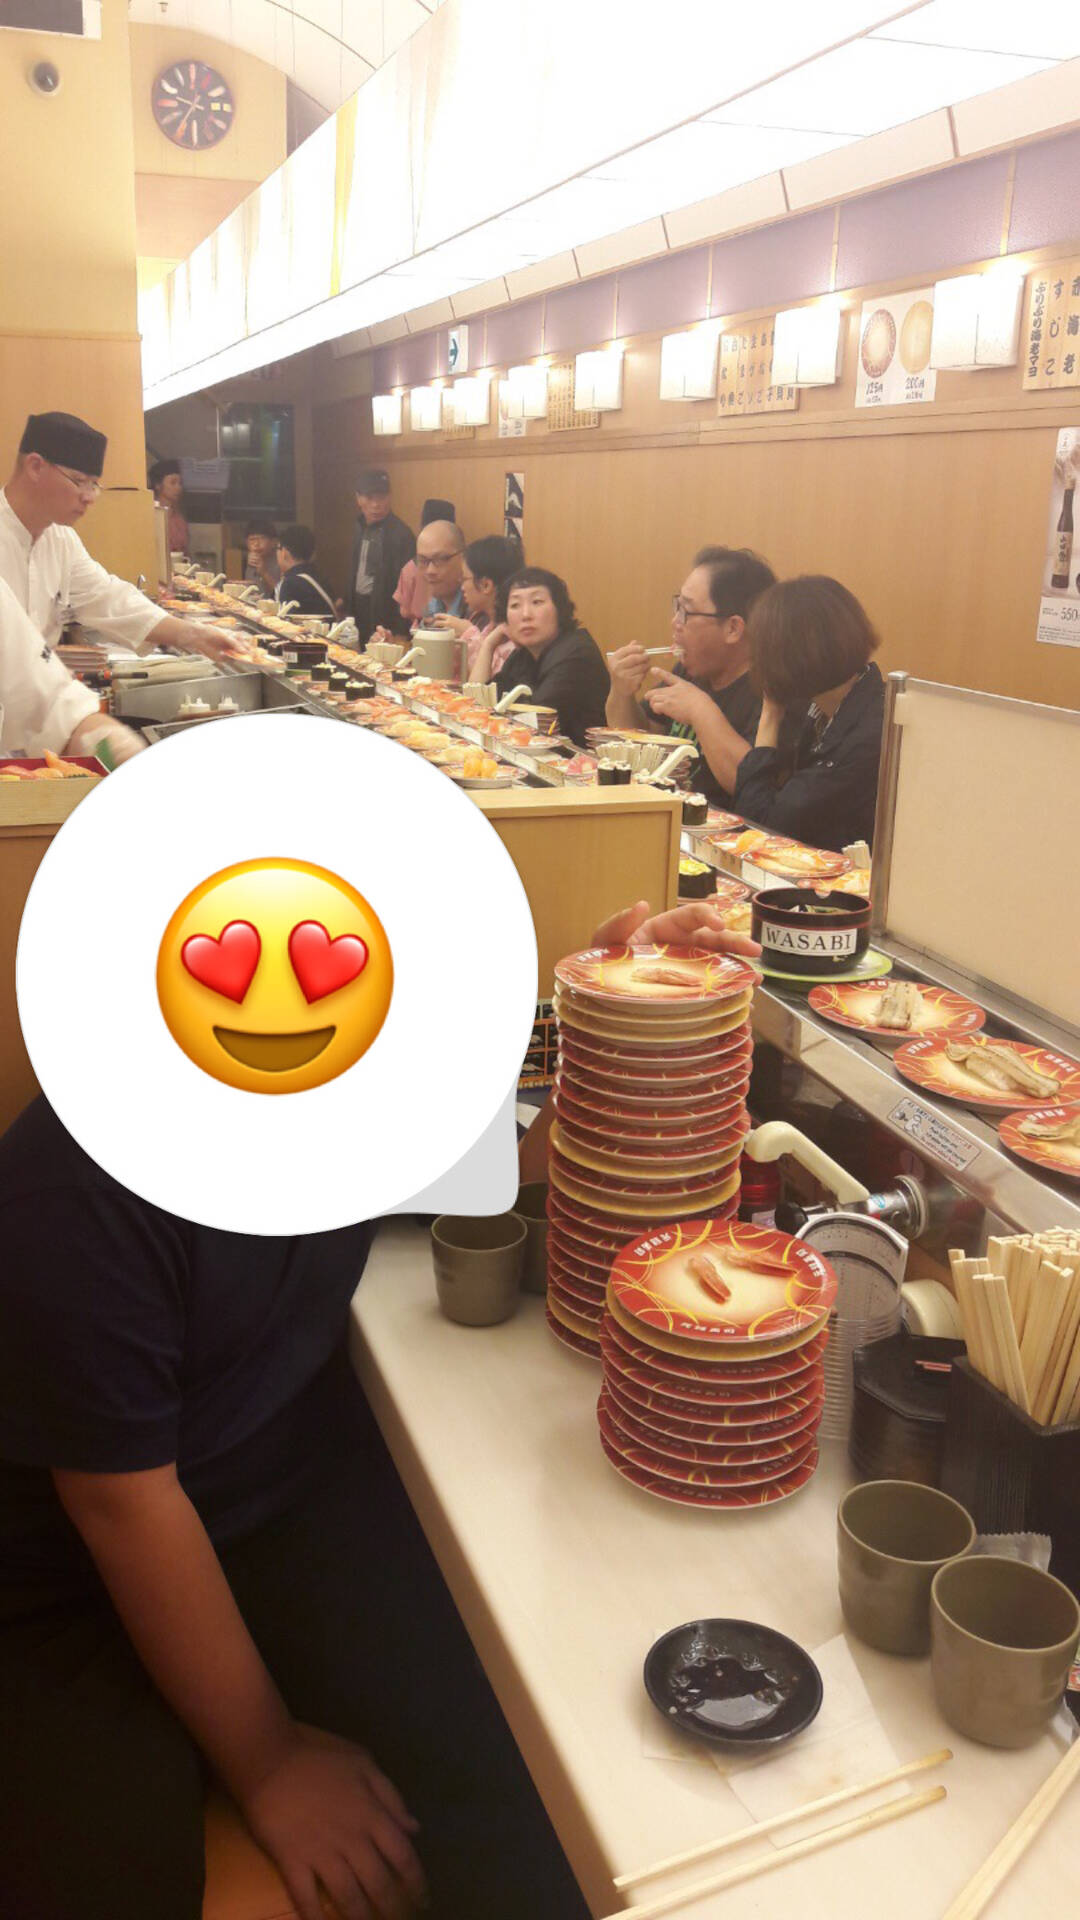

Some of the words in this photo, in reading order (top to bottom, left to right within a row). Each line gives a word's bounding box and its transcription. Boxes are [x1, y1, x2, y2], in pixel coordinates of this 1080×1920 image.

[1045, 279, 1064, 376] すじこ
[767, 927, 851, 950] WASABI
